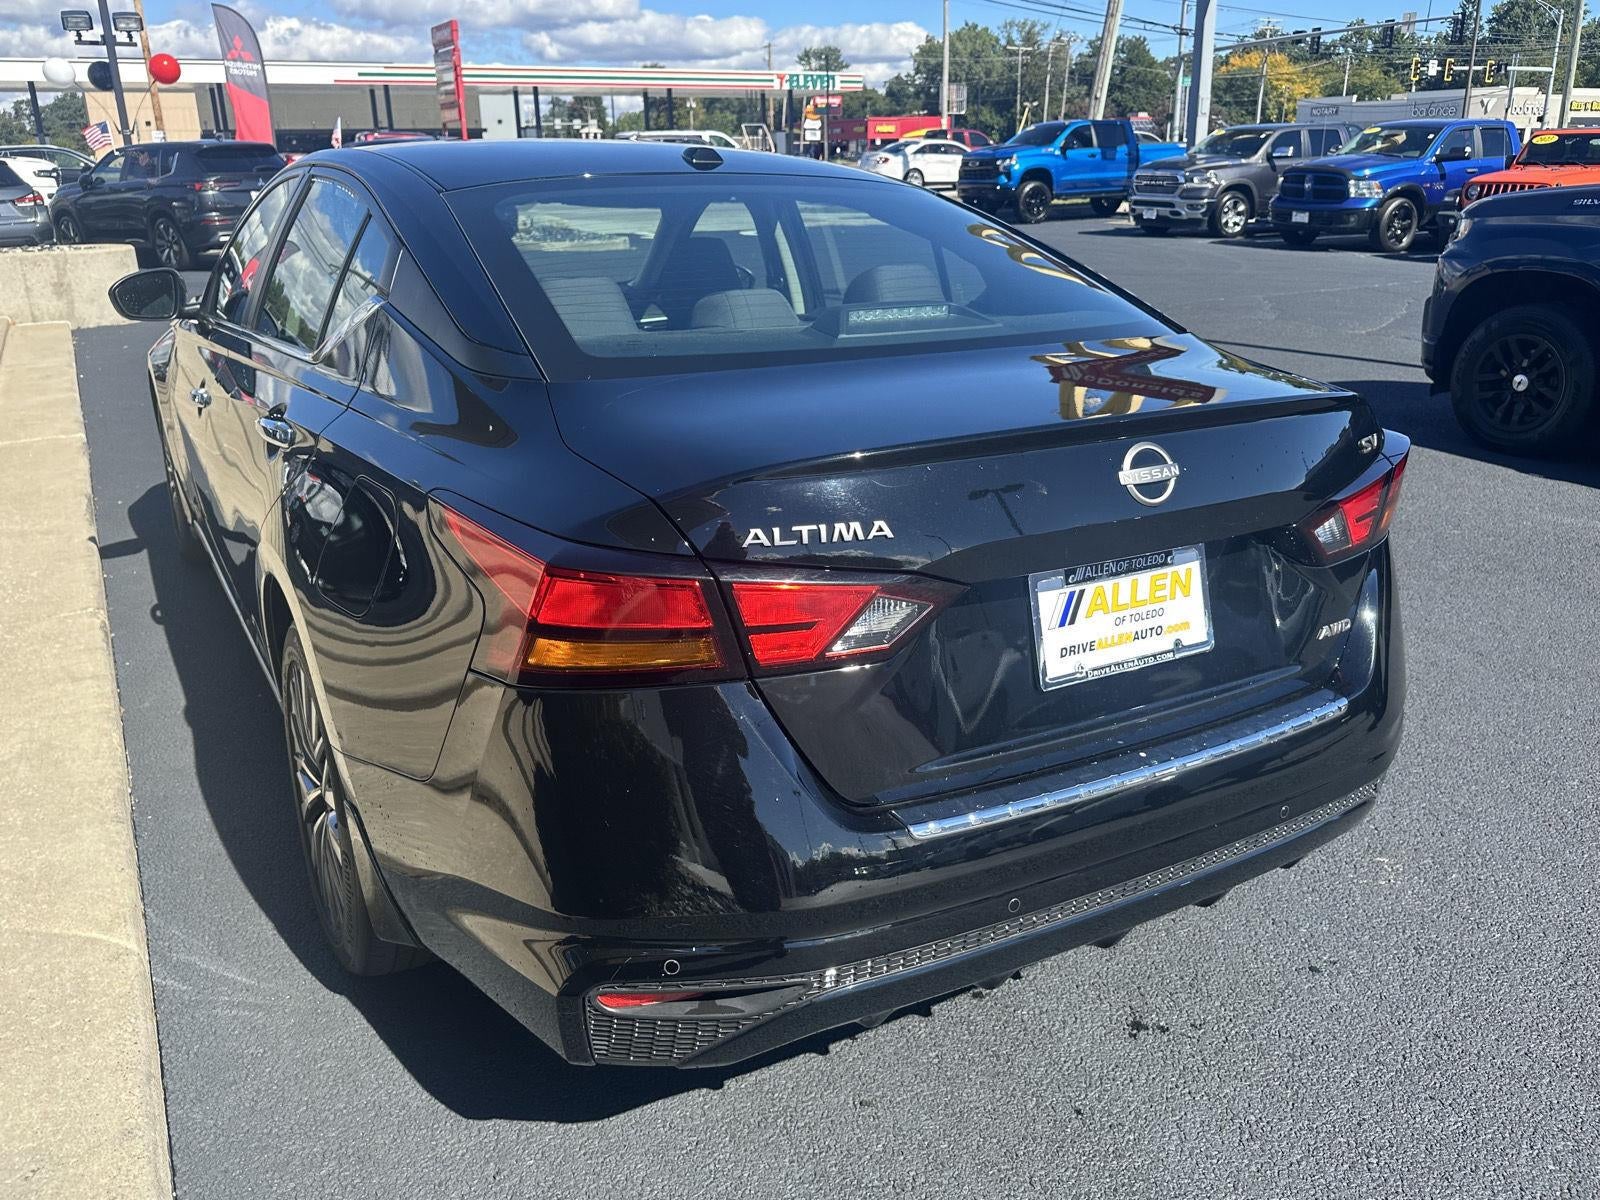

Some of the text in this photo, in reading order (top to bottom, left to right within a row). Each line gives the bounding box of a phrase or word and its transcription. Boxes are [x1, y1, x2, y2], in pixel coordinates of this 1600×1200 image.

[1311, 107, 1338, 116] NOTARY
[1411, 102, 1457, 117] balance
[1357, 433, 1378, 454] SV
[1122, 463, 1180, 484] NISSAN
[742, 519, 895, 549] ALTIMA
[1085, 553, 1165, 579] ALLEN OF TOLEDO
[1085, 567, 1192, 619] ALLEN
[1114, 607, 1165, 627] OF TOLEDO
[1317, 618, 1352, 640] AWD
[1059, 621, 1191, 659] DRIVEALLENAUTO.com
